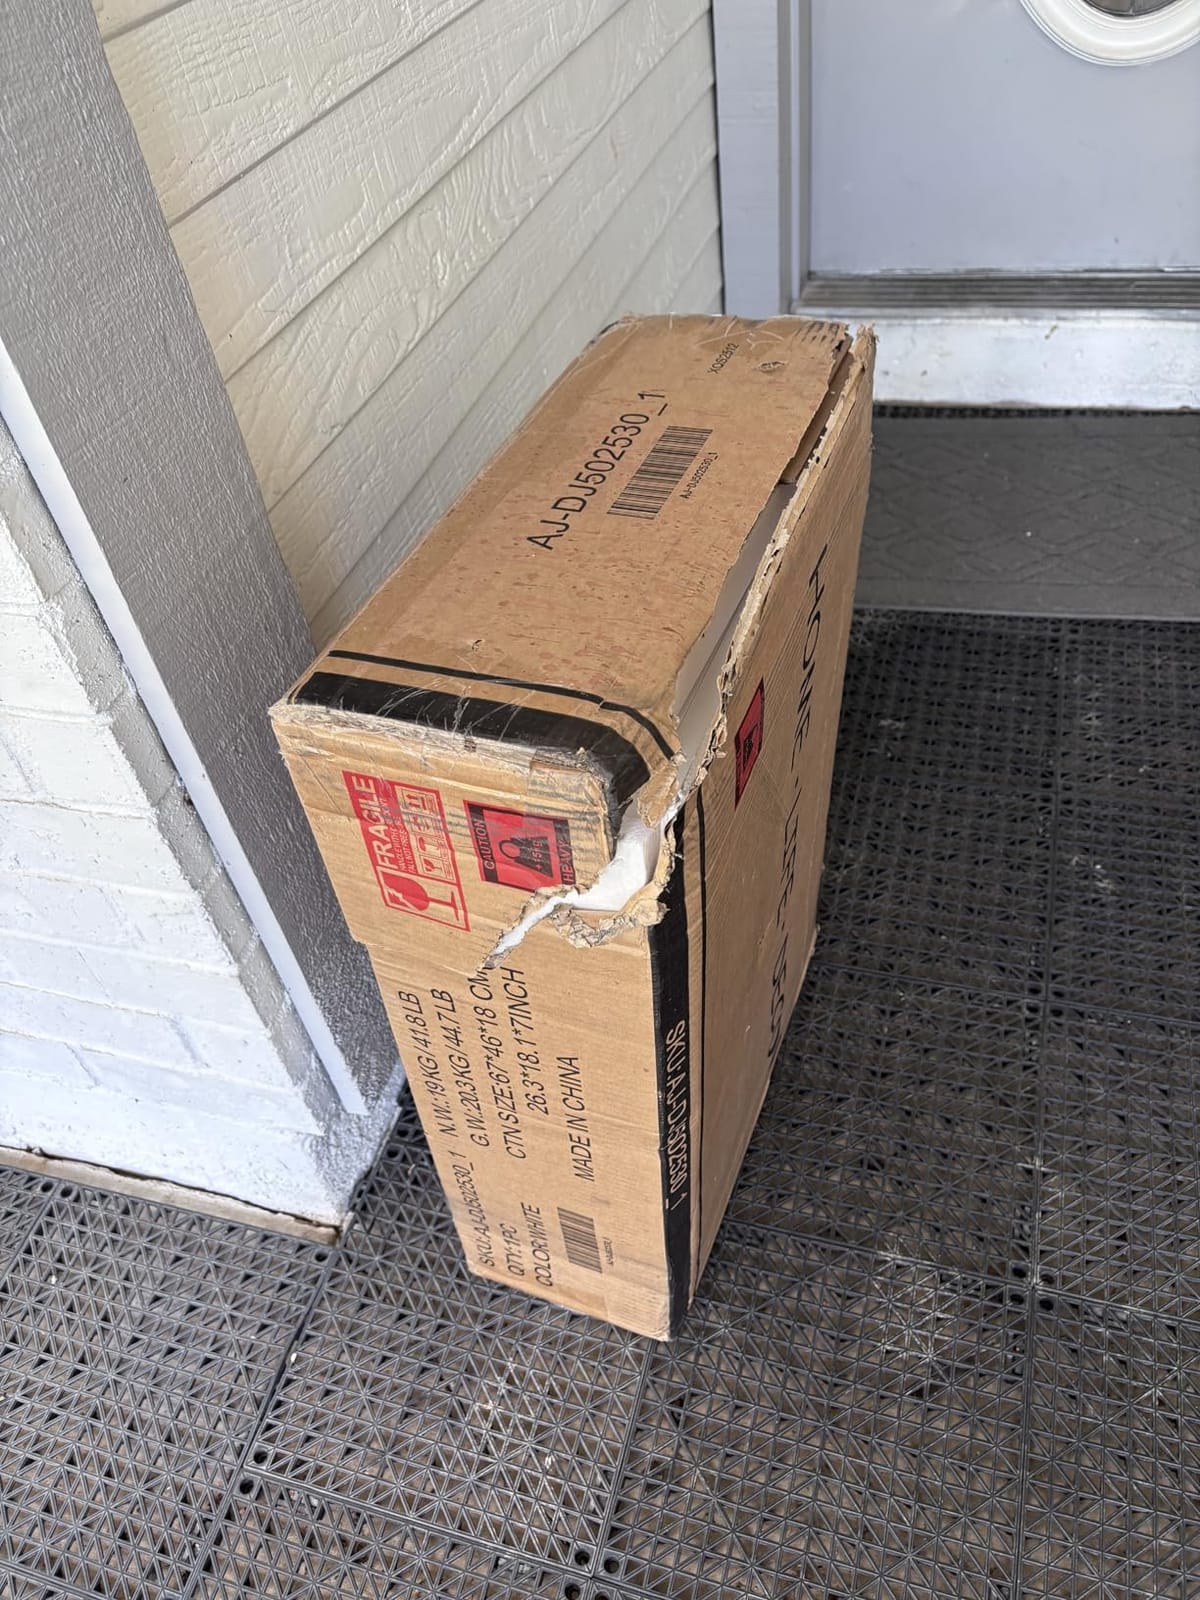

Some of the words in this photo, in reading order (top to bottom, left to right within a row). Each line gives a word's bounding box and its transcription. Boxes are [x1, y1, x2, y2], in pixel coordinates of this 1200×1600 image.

[527, 392, 668, 550] AJ-DJ502530_1
[791, 544, 828, 772] HOME
[352, 775, 399, 870] FRAGILE
[475, 820, 495, 870] CAUTION
[560, 838, 574, 883] HEAVY
[777, 788, 802, 928] LIFE
[557, 1056, 585, 1111] CHINA
[501, 1124, 527, 1159] CTN
[567, 1115, 590, 1132] IN
[569, 1133, 595, 1181] MADE
[500, 1223, 525, 1276] QTY:1PC
